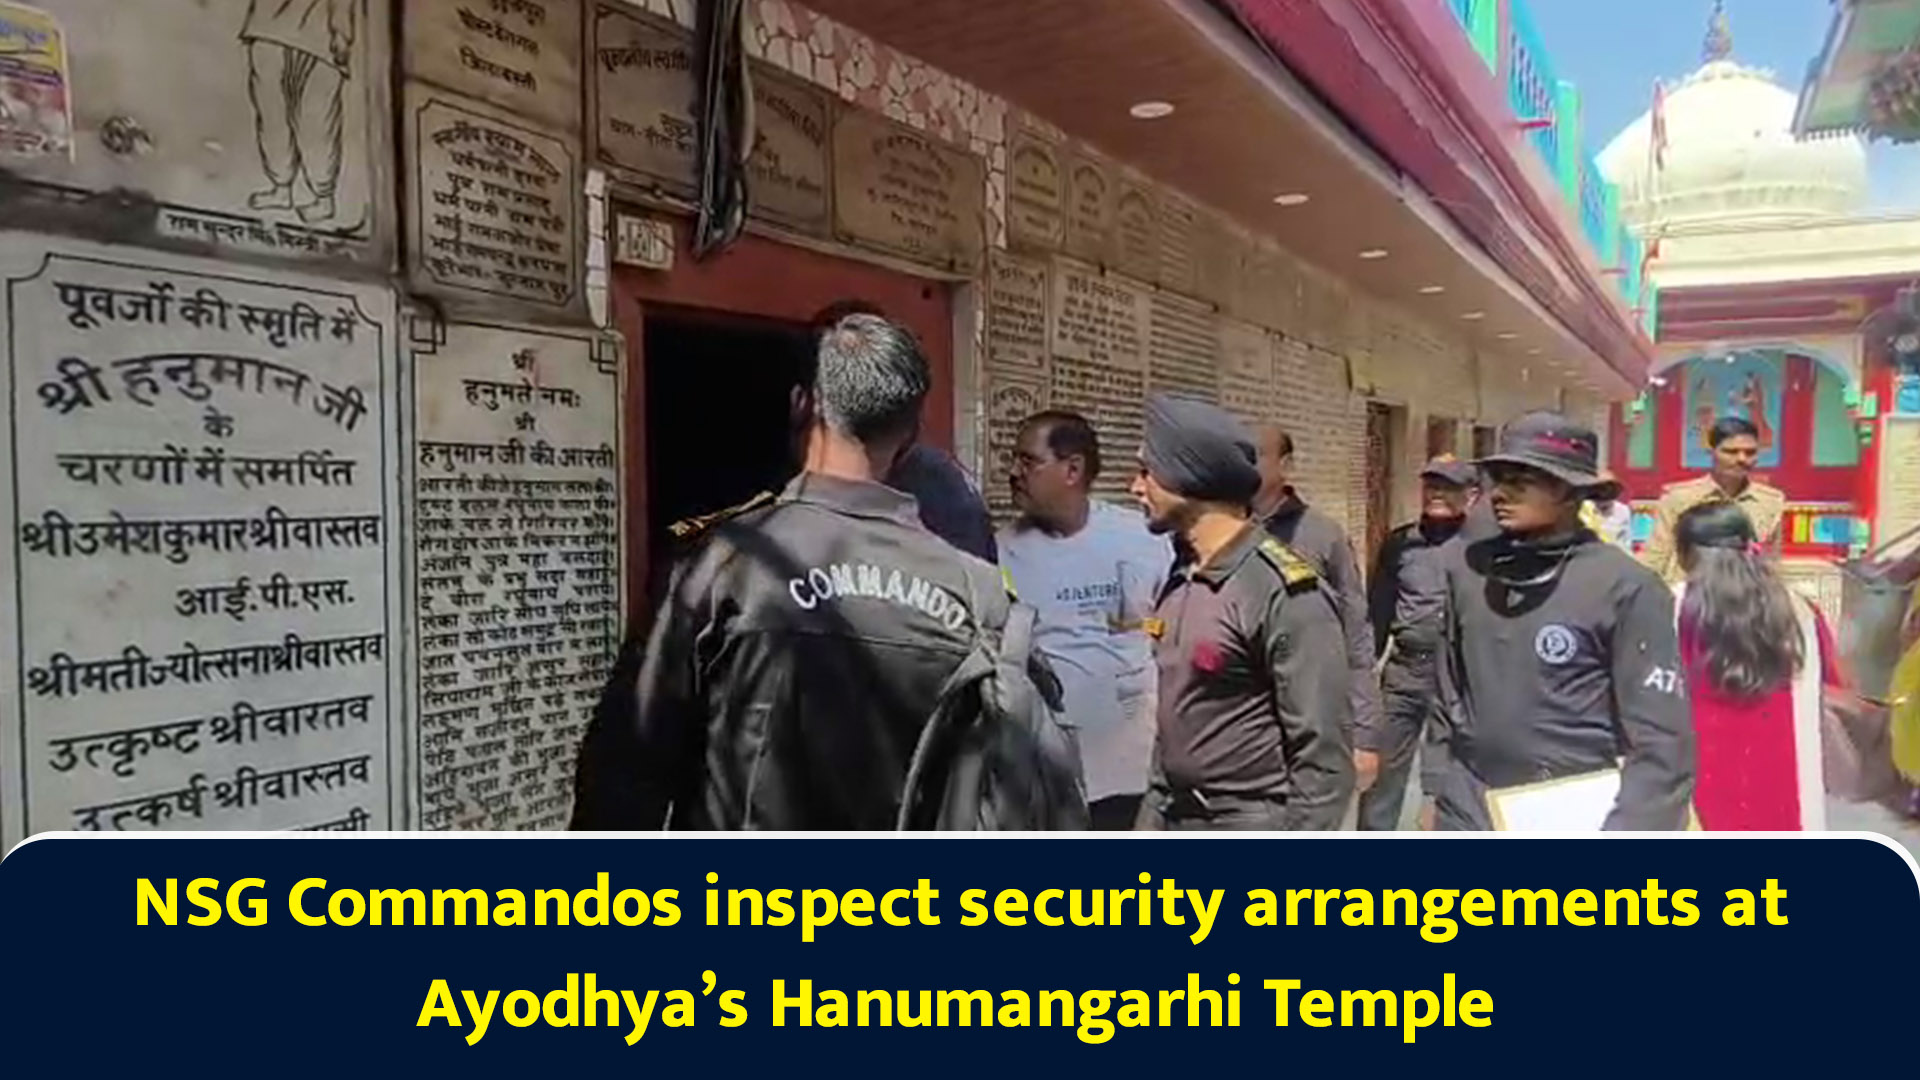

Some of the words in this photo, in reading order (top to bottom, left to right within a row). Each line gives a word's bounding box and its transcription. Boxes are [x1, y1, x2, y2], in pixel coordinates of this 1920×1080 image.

[180, 288, 227, 331] की
[238, 302, 321, 348] स्मृति
[330, 307, 357, 343] में
[37, 357, 112, 414] श्री
[111, 353, 309, 406] हनुमान
[313, 383, 368, 432] जी
[461, 377, 533, 411] हनुमते
[538, 385, 580, 408] नमः
[202, 405, 234, 439] के
[55, 444, 188, 486] चरणों
[194, 448, 225, 486] में
[232, 450, 356, 489] समर्पित
[418, 440, 494, 472] हनुमान
[497, 438, 525, 465] जी
[529, 439, 555, 466] की
[557, 443, 615, 468] आरती
[174, 573, 355, 622] आई.पी.एस.
[789, 562, 967, 630] COMMANDO
[28, 644, 151, 698] श्रीमती
[272, 633, 383, 673] श्रीवास्तव
[48, 719, 204, 777] उत्कृष्ट
[213, 754, 372, 809] श्रीवास्तव
